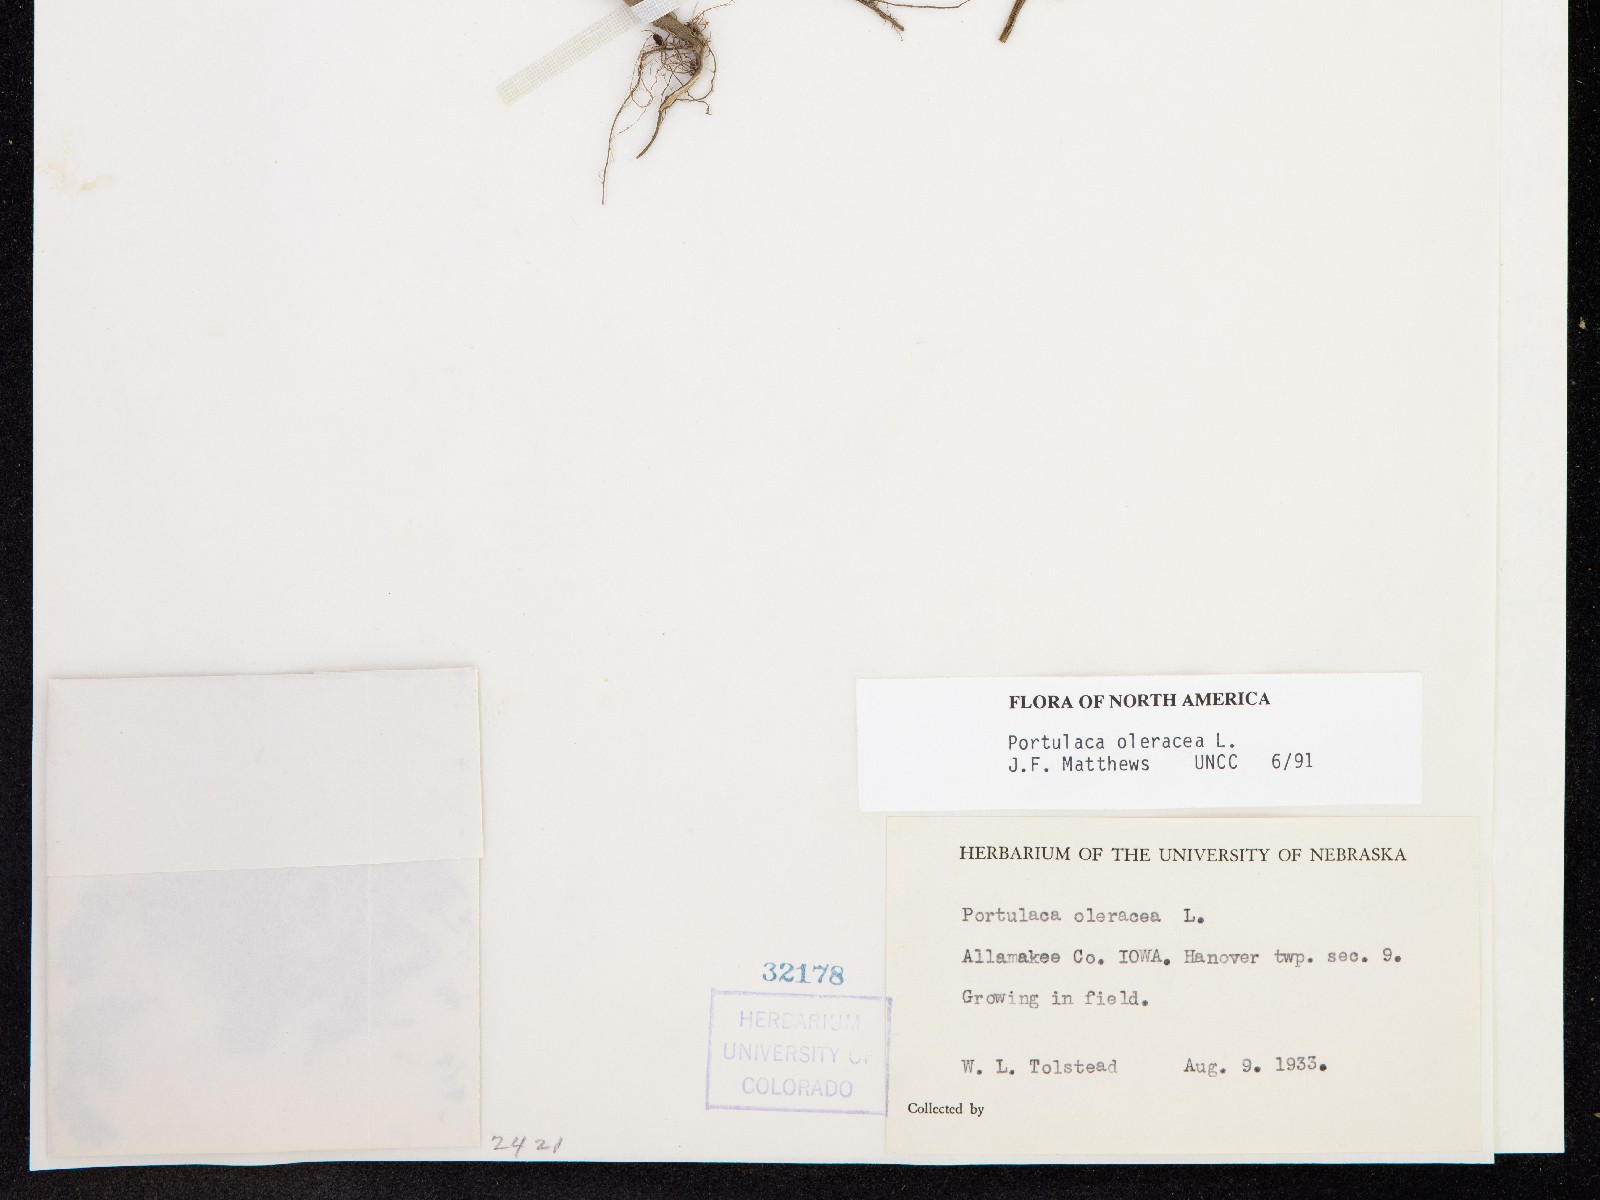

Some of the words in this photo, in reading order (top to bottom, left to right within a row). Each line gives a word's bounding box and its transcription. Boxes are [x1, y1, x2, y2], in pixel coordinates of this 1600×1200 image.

[1009, 695, 1074, 709] FLORA
[1079, 695, 1104, 709] OF
[1109, 694, 1176, 708] NORTH
[1182, 692, 1270, 706] AMERICA
[1009, 734, 1104, 750] Portulaca
[1118, 733, 1204, 749] oleracea
[1217, 733, 1234, 748] L.
[1009, 757, 1048, 772] J.F.
[1063, 756, 1149, 771] Matthews
[1195, 754, 1237, 769] UNCC
[1272, 753, 1312, 770] 6/91
[960, 846, 1070, 860] HERBARIUM
[1079, 848, 1103, 861] OF
[1111, 848, 1150, 861] THE
[1159, 848, 1270, 861] UNIVERSITY
[1279, 849, 1302, 861] OF
[1310, 848, 1407, 861] NEBRASKA
[962, 908, 1061, 922] Portulaca
[1074, 908, 1161, 922] oleracea
[1184, 908, 1204, 924] L.
[962, 949, 1060, 964] Allamakee
[1074, 949, 1104, 965] Co.
[1119, 949, 1170, 966] IOWA.
[1184, 950, 1259, 964] Hanover
[1274, 950, 1313, 967] twp.
[1328, 952, 1368, 962] sec.
[1383, 948, 1401, 962] 9.
[762, 962, 845, 986] 32178
[963, 990, 1039, 1008] Growing
[1052, 991, 1073, 1005] in
[1085, 991, 1148, 1006] field.
[723, 1042, 840, 1064] UNIVERSITY
[961, 1060, 982, 1075] W.
[996, 1059, 1014, 1075] L.
[1030, 1059, 1117, 1074] Tolstead
[1183, 1058, 1226, 1077] Aug.
[1243, 1059, 1261, 1073] 9.
[1276, 1056, 1327, 1072] 1933.
[742, 1076, 853, 1098] COLORADO
[908, 1102, 962, 1114] Collected
[970, 1103, 984, 1117] by
